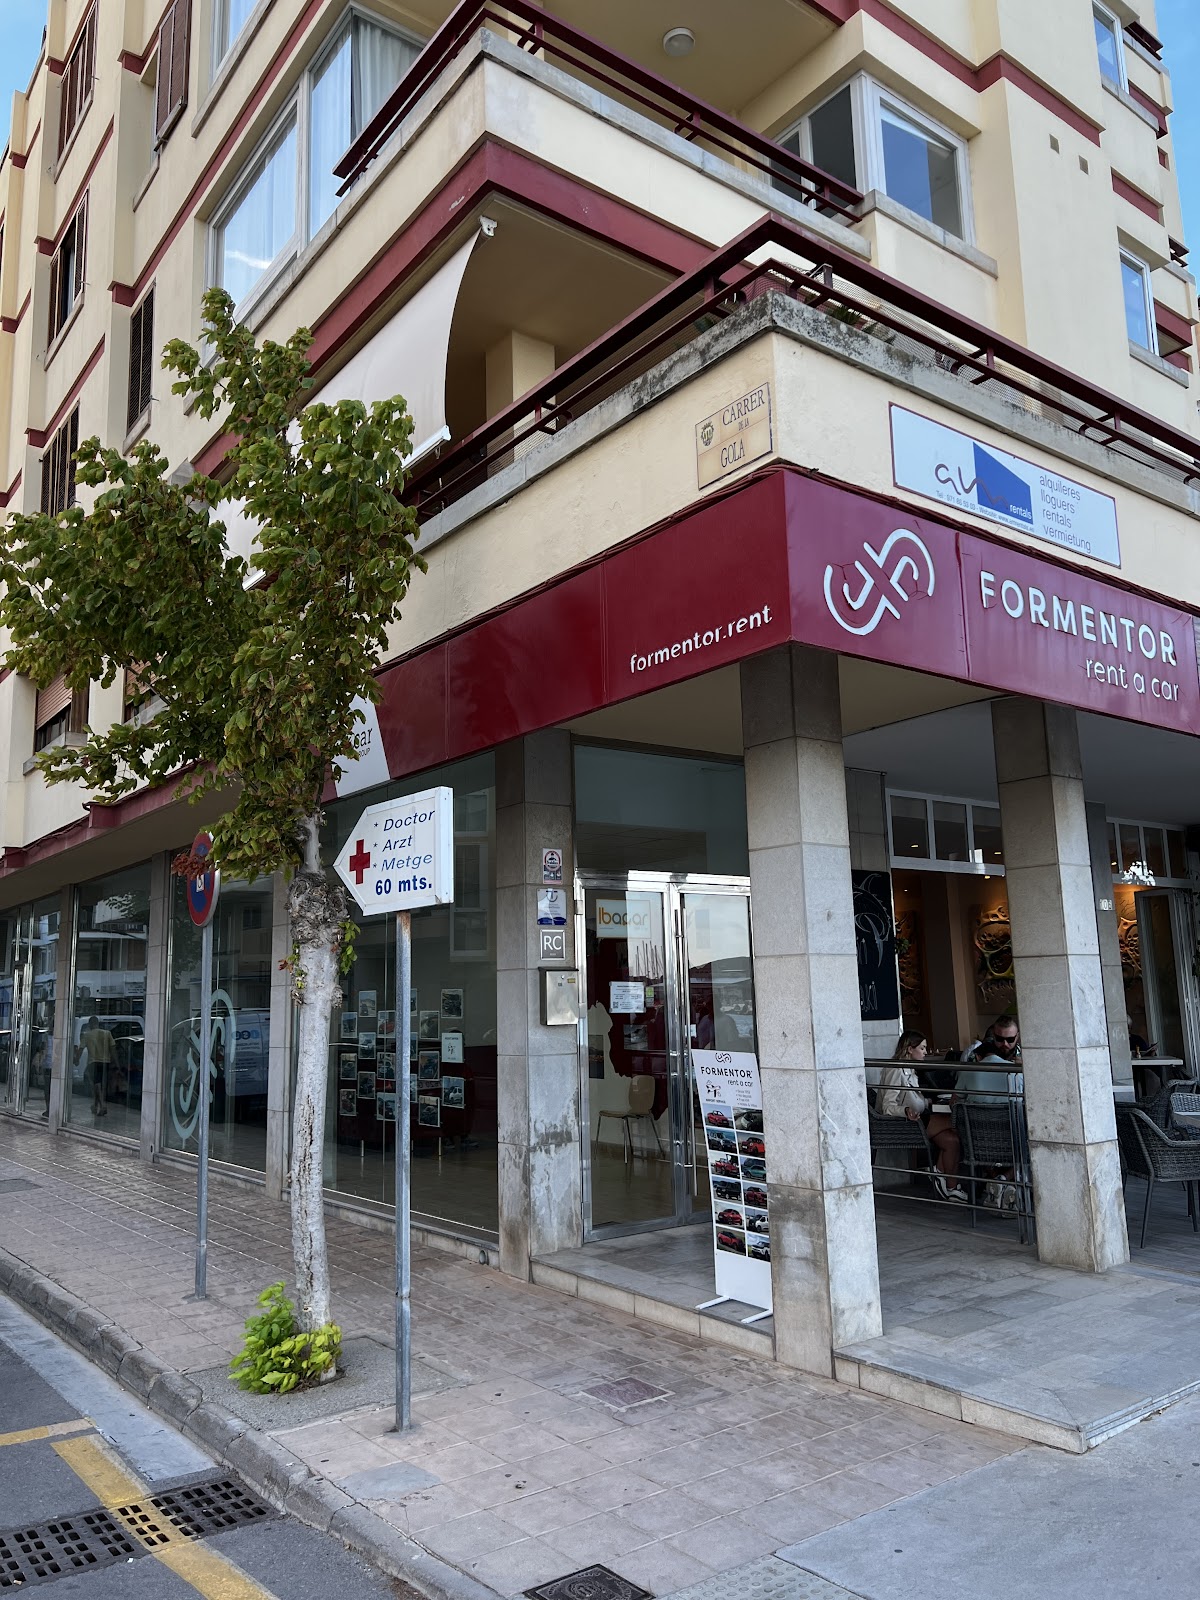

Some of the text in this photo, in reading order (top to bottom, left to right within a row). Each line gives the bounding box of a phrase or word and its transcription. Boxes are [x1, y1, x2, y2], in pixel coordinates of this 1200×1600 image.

[722, 389, 765, 426] CARRER
[738, 418, 750, 431] DE LA
[720, 438, 745, 468] GOLA
[1039, 473, 1081, 501] alquileres
[1009, 504, 1032, 520] rentals
[1040, 489, 1075, 514] lloguers
[1042, 507, 1072, 529] rentals
[1043, 525, 1091, 554] vermietung
[980, 570, 1177, 667] FORMENTOR
[630, 605, 773, 674] formentor.rent
[1086, 658, 1179, 702] rent a car
[383, 809, 436, 832] Doctor
[382, 834, 413, 852] Arzt
[381, 852, 433, 872] Metge
[375, 875, 433, 896] 60 mts.
[543, 935, 562, 951] RC
[700, 1066, 752, 1079] FORMENTOR
